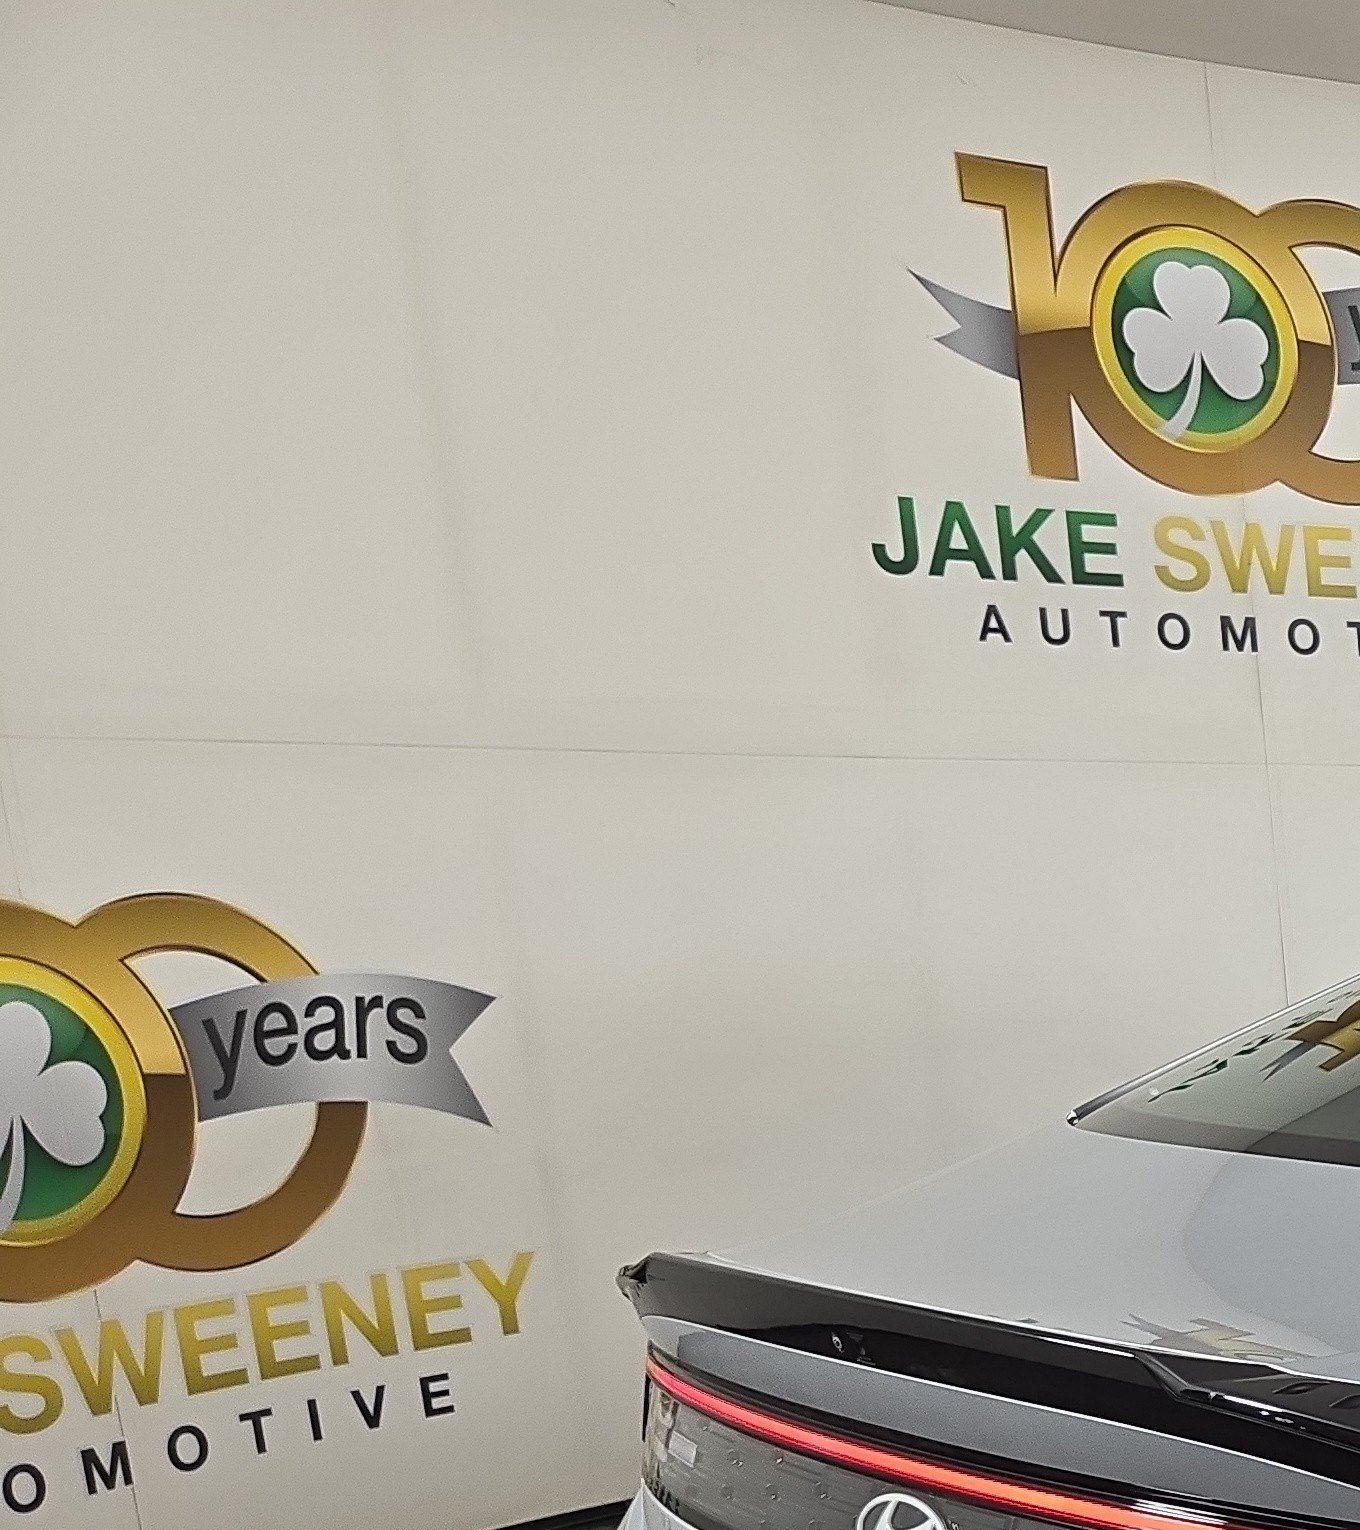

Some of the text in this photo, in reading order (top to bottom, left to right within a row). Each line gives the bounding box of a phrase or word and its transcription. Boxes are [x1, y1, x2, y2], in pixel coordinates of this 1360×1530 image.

[871, 496, 1125, 588] JAKE
[0, 891, 428, 1303] 00 years
[0, 1251, 535, 1434] SWEENEY
[2, 1372, 456, 1514] OMOTIVE
